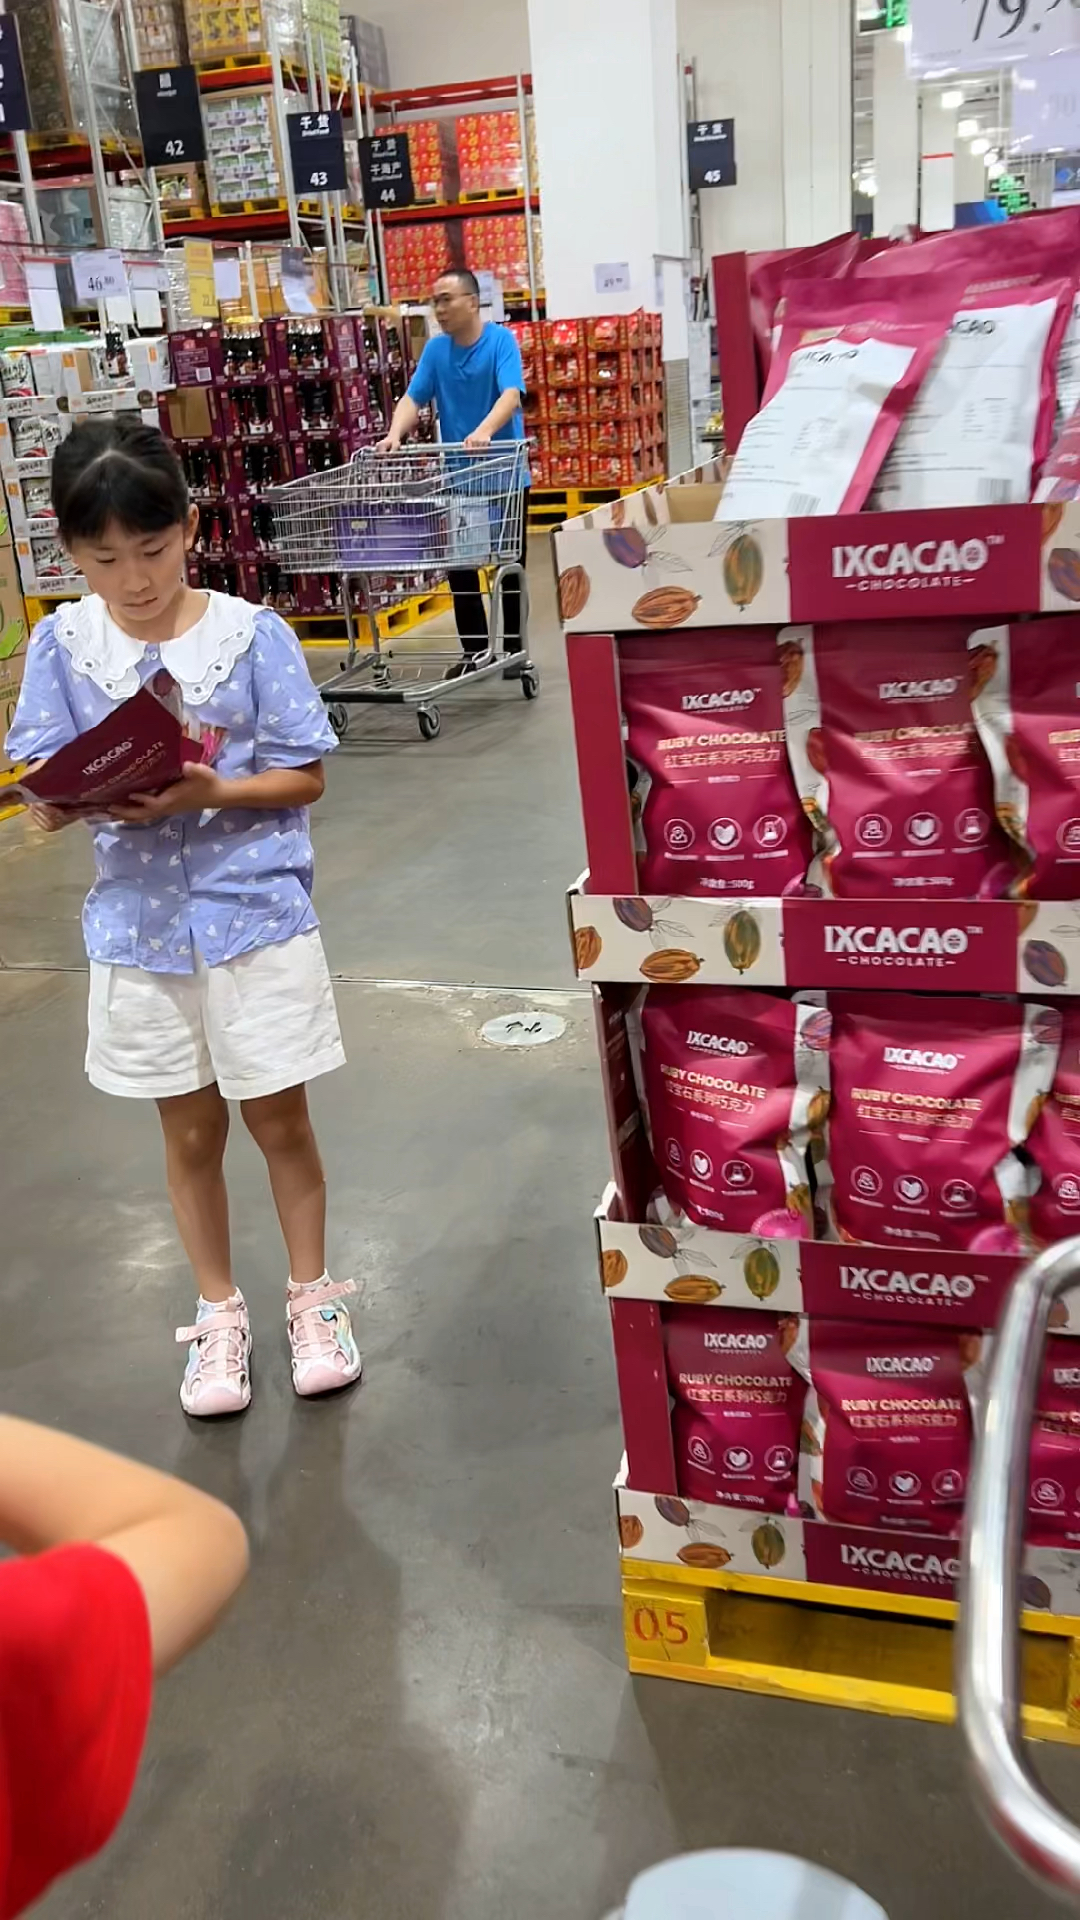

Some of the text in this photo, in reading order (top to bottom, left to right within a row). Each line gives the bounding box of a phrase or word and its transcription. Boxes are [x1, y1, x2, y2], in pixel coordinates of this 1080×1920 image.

[165, 140, 185, 156] 42
[310, 172, 328, 186] 43
[704, 170, 721, 183] 45
[380, 188, 396, 202] 44
[857, 576, 963, 591] CHOCOLATE
[657, 729, 786, 750] RUBY CHOCOLATE
[847, 955, 946, 968] CHOCOLATE
[687, 1071, 767, 1099] CHOCOLATE
[851, 1088, 983, 1111] RUBY CHOCOLATE
[679, 1373, 793, 1388] RUBY CHOCOLATE
[634, 1607, 689, 1645] 05
